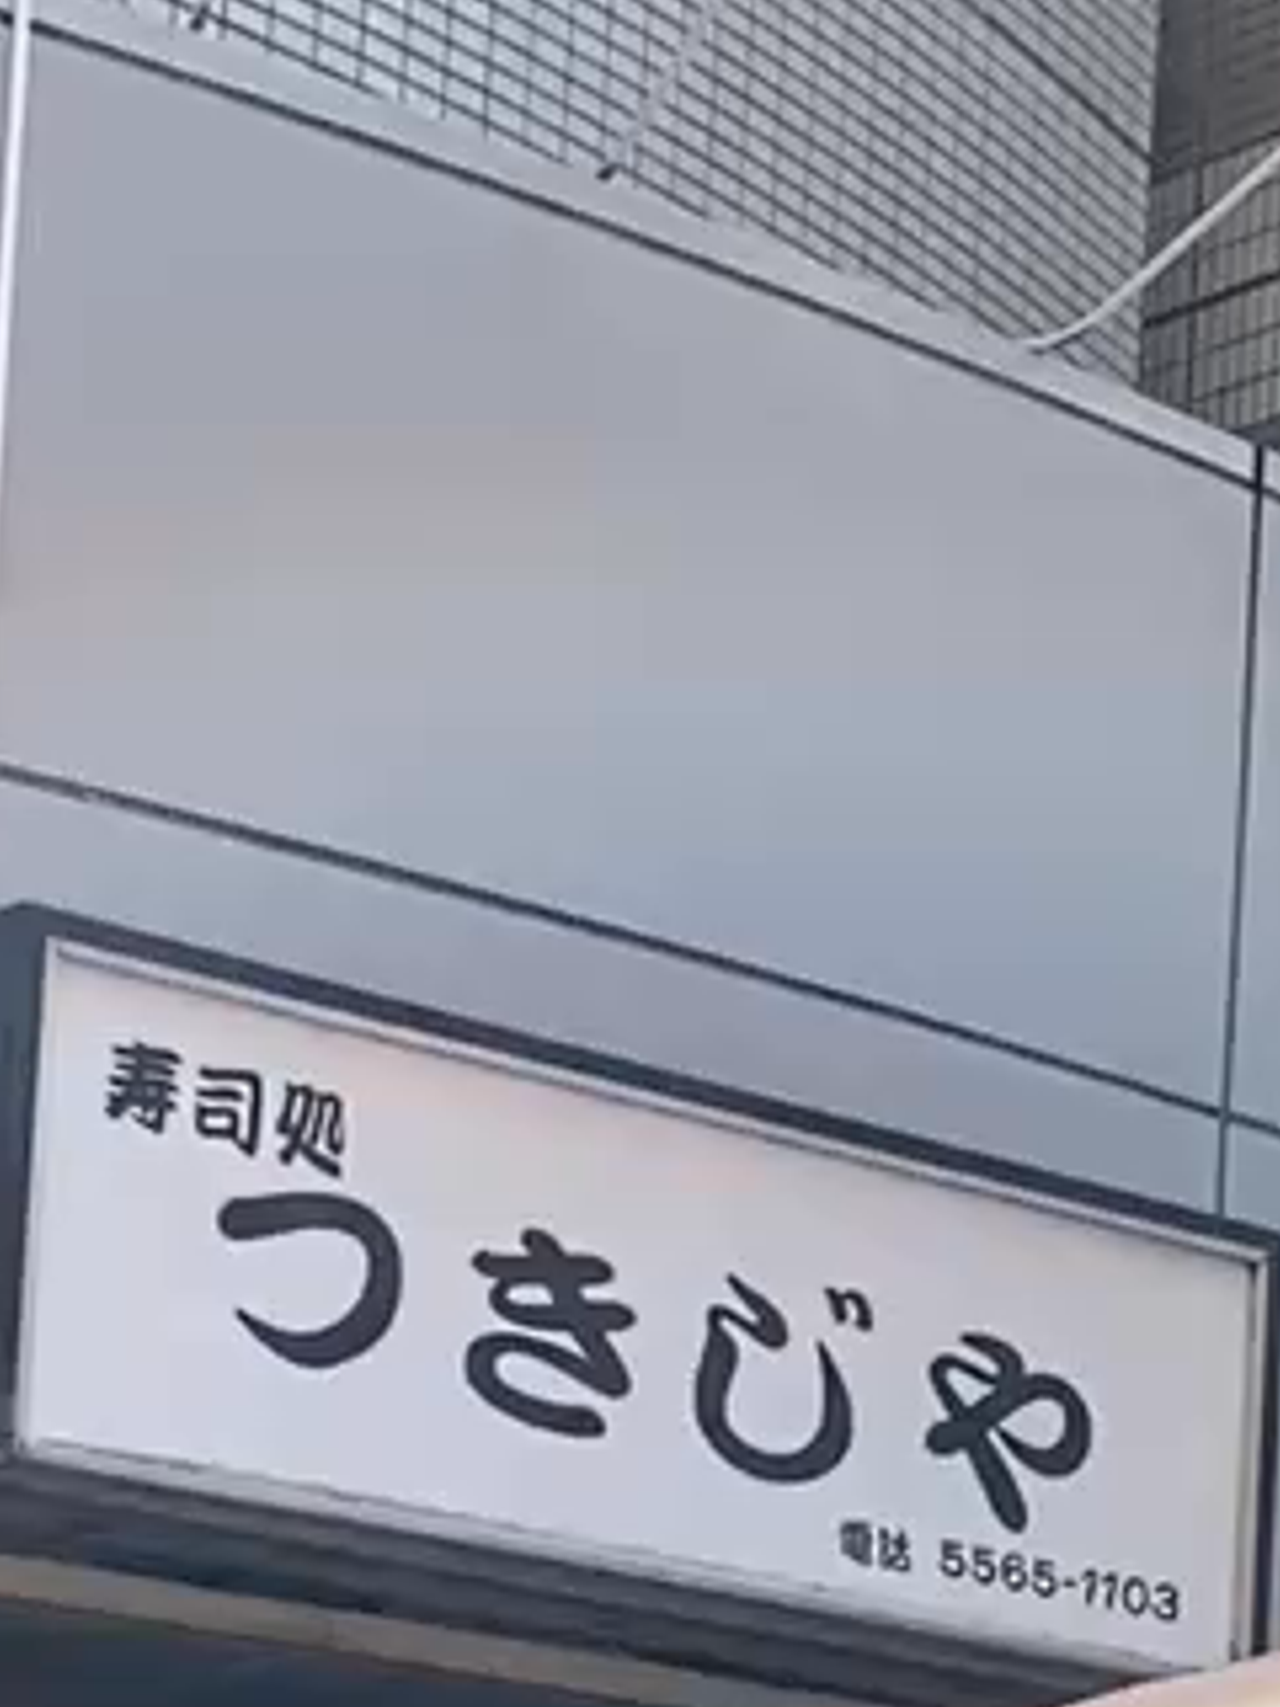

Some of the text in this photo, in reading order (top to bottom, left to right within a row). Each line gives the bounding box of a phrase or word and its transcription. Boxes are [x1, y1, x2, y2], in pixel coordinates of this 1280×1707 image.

[104, 1041, 346, 1177] 寿司処
[217, 1191, 1092, 1534] つきじや
[937, 1538, 1181, 1622] 5565-1103
